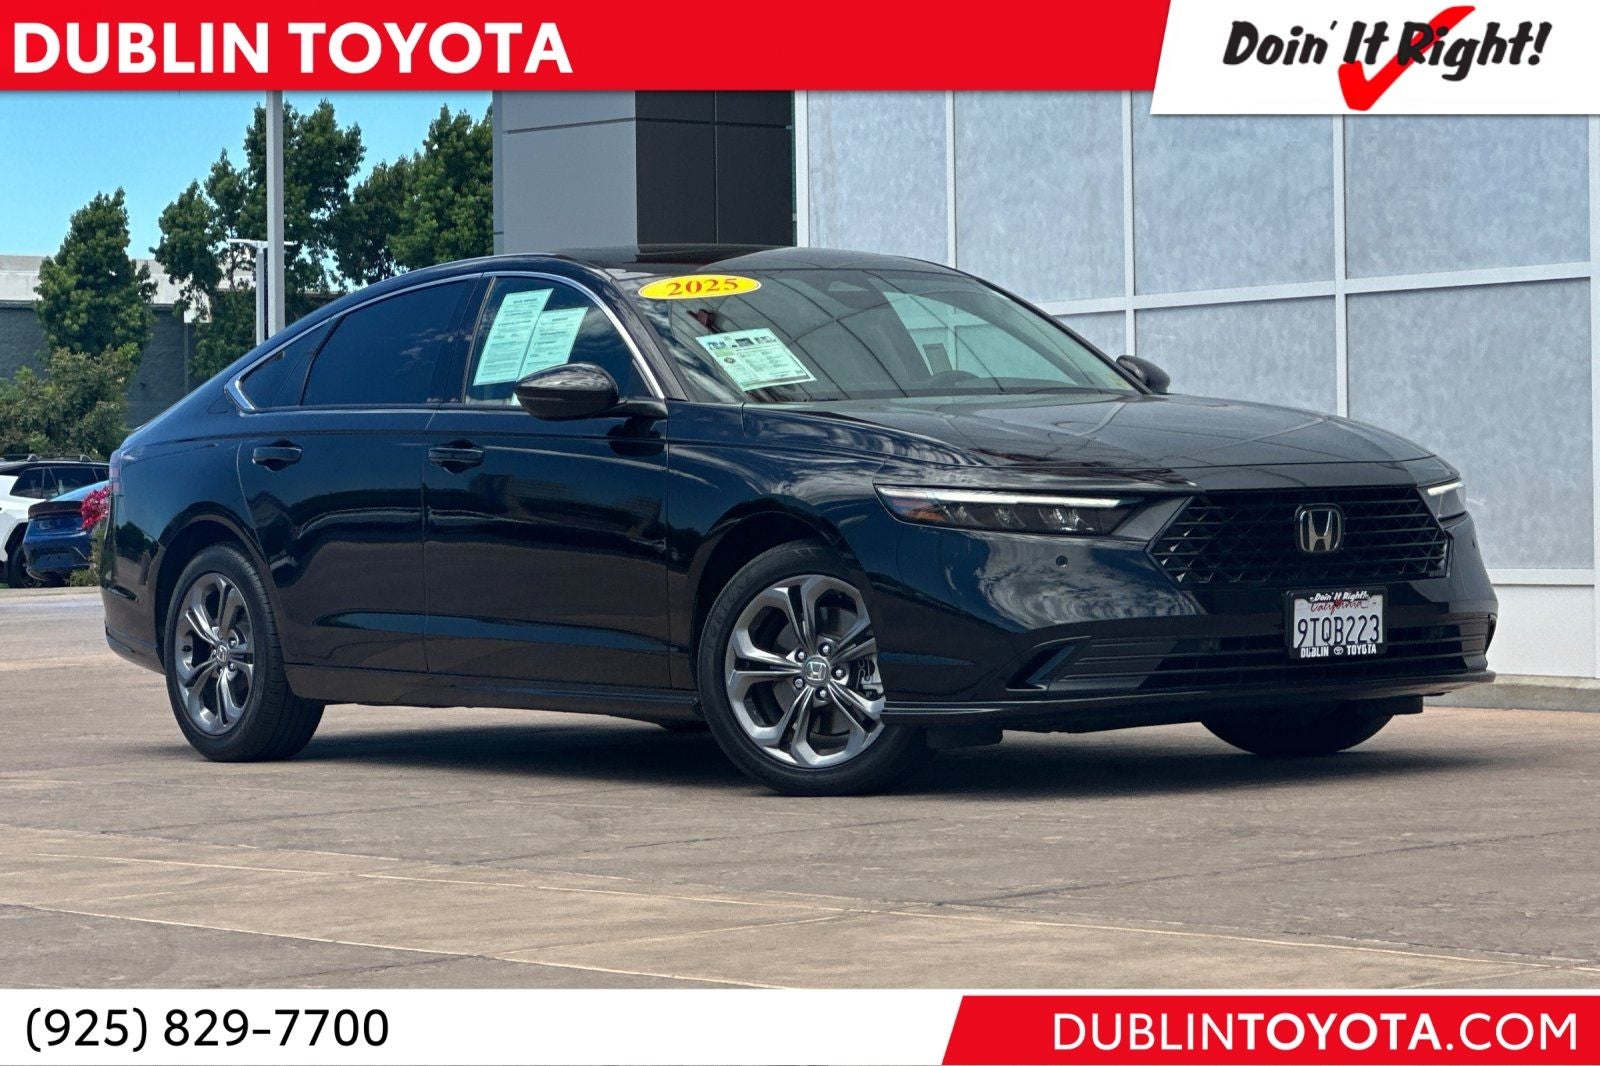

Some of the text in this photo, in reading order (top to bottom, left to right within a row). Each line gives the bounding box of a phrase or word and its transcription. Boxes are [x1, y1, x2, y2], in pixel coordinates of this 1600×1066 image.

[666, 278, 738, 297] 2025
[1297, 614, 1380, 649] 9TQB223
[1300, 643, 1377, 659] DUBLIN TOYOTA
